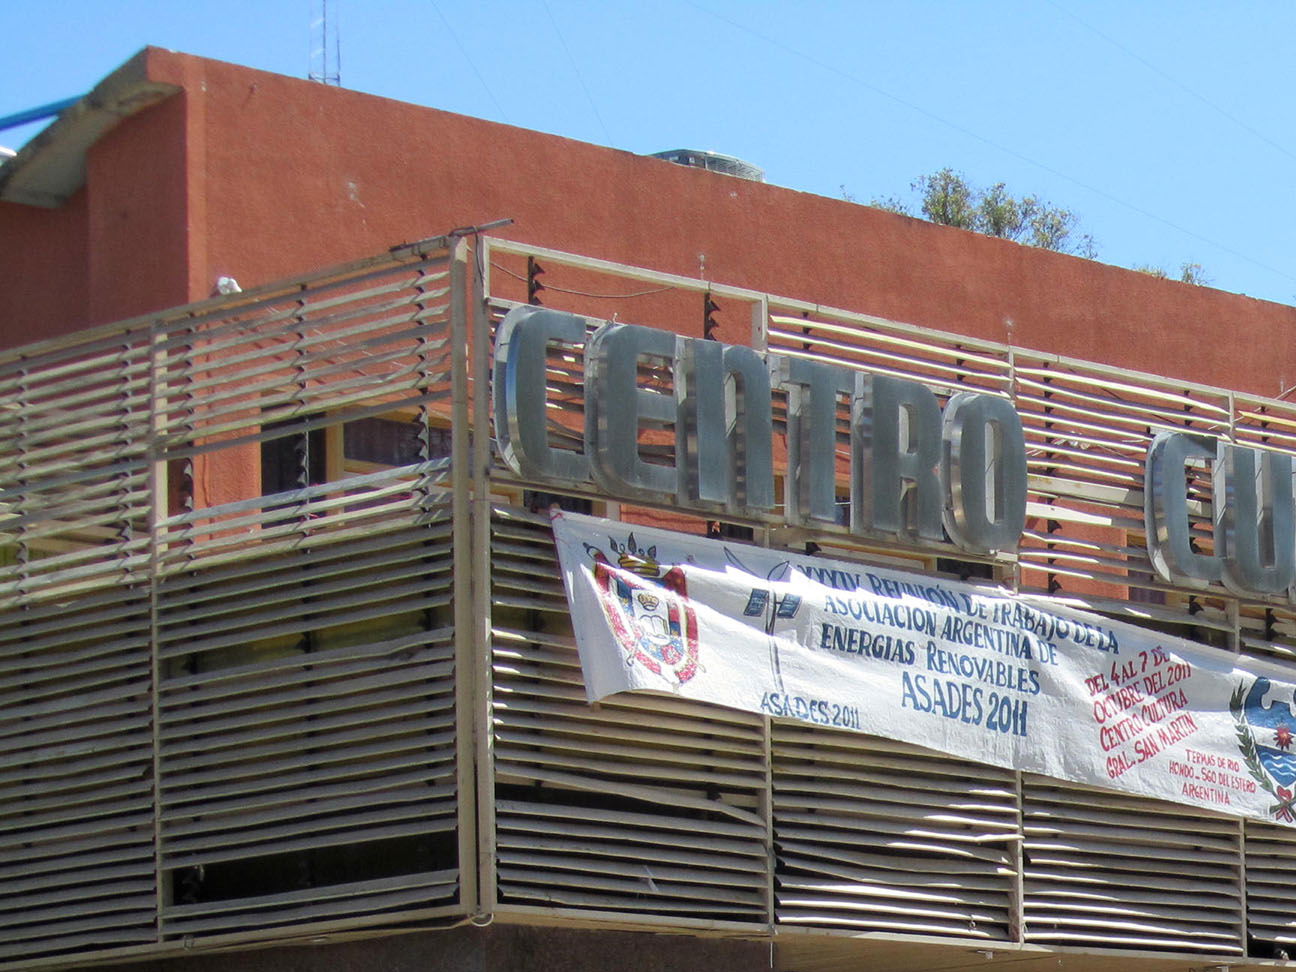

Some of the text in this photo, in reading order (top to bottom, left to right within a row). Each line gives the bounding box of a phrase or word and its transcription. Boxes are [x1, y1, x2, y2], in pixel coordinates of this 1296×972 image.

[495, 305, 1027, 555] CENTRO
[823, 595, 1059, 665] ASOCIACION ARGENTINA DE
[960, 592, 988, 620] DE
[992, 599, 1070, 641] TRABAJO
[820, 623, 1041, 695] ENERGIAS RENOVABLES
[1084, 674, 1110, 697] DEL
[1110, 661, 1121, 686] 4
[1138, 650, 1148, 672] 7
[1150, 645, 1170, 667] DE
[760, 691, 861, 729] ASADES 2011
[902, 671, 1028, 736] ASADES 2011
[1093, 662, 1191, 723] OCTUBRE DEL 2011
[1099, 688, 1188, 751] CENTRO CULTURA
[1106, 712, 1198, 779] GRAL. SAN MARTIN
[1185, 749, 1216, 767] TERMAS
[1217, 757, 1226, 769] DE
[1182, 782, 1231, 805] ARGENTINA
[1200, 767, 1217, 784] SGO
[1218, 773, 1230, 787] DEL
